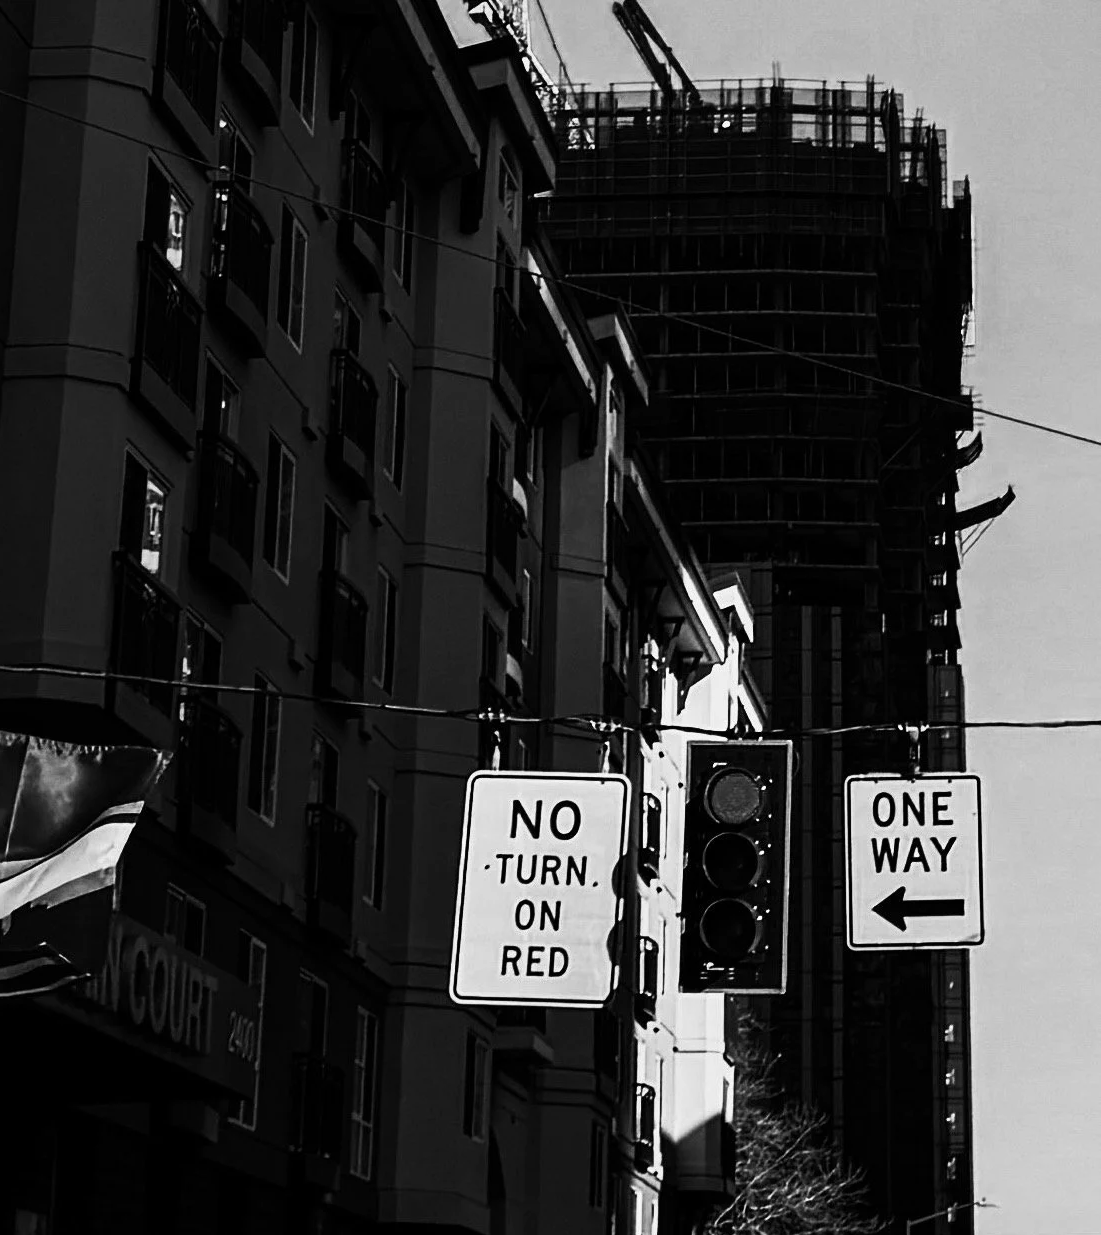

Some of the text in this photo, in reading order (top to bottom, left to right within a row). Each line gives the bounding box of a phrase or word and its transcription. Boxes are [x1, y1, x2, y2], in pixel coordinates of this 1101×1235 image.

[510, 799, 582, 841] NO
[871, 791, 954, 827] ONE
[496, 854, 587, 887] TURN
[871, 837, 957, 873] WAY
[515, 899, 561, 932] ON
[500, 945, 569, 978] RED
[130, 935, 218, 1056] COURT
